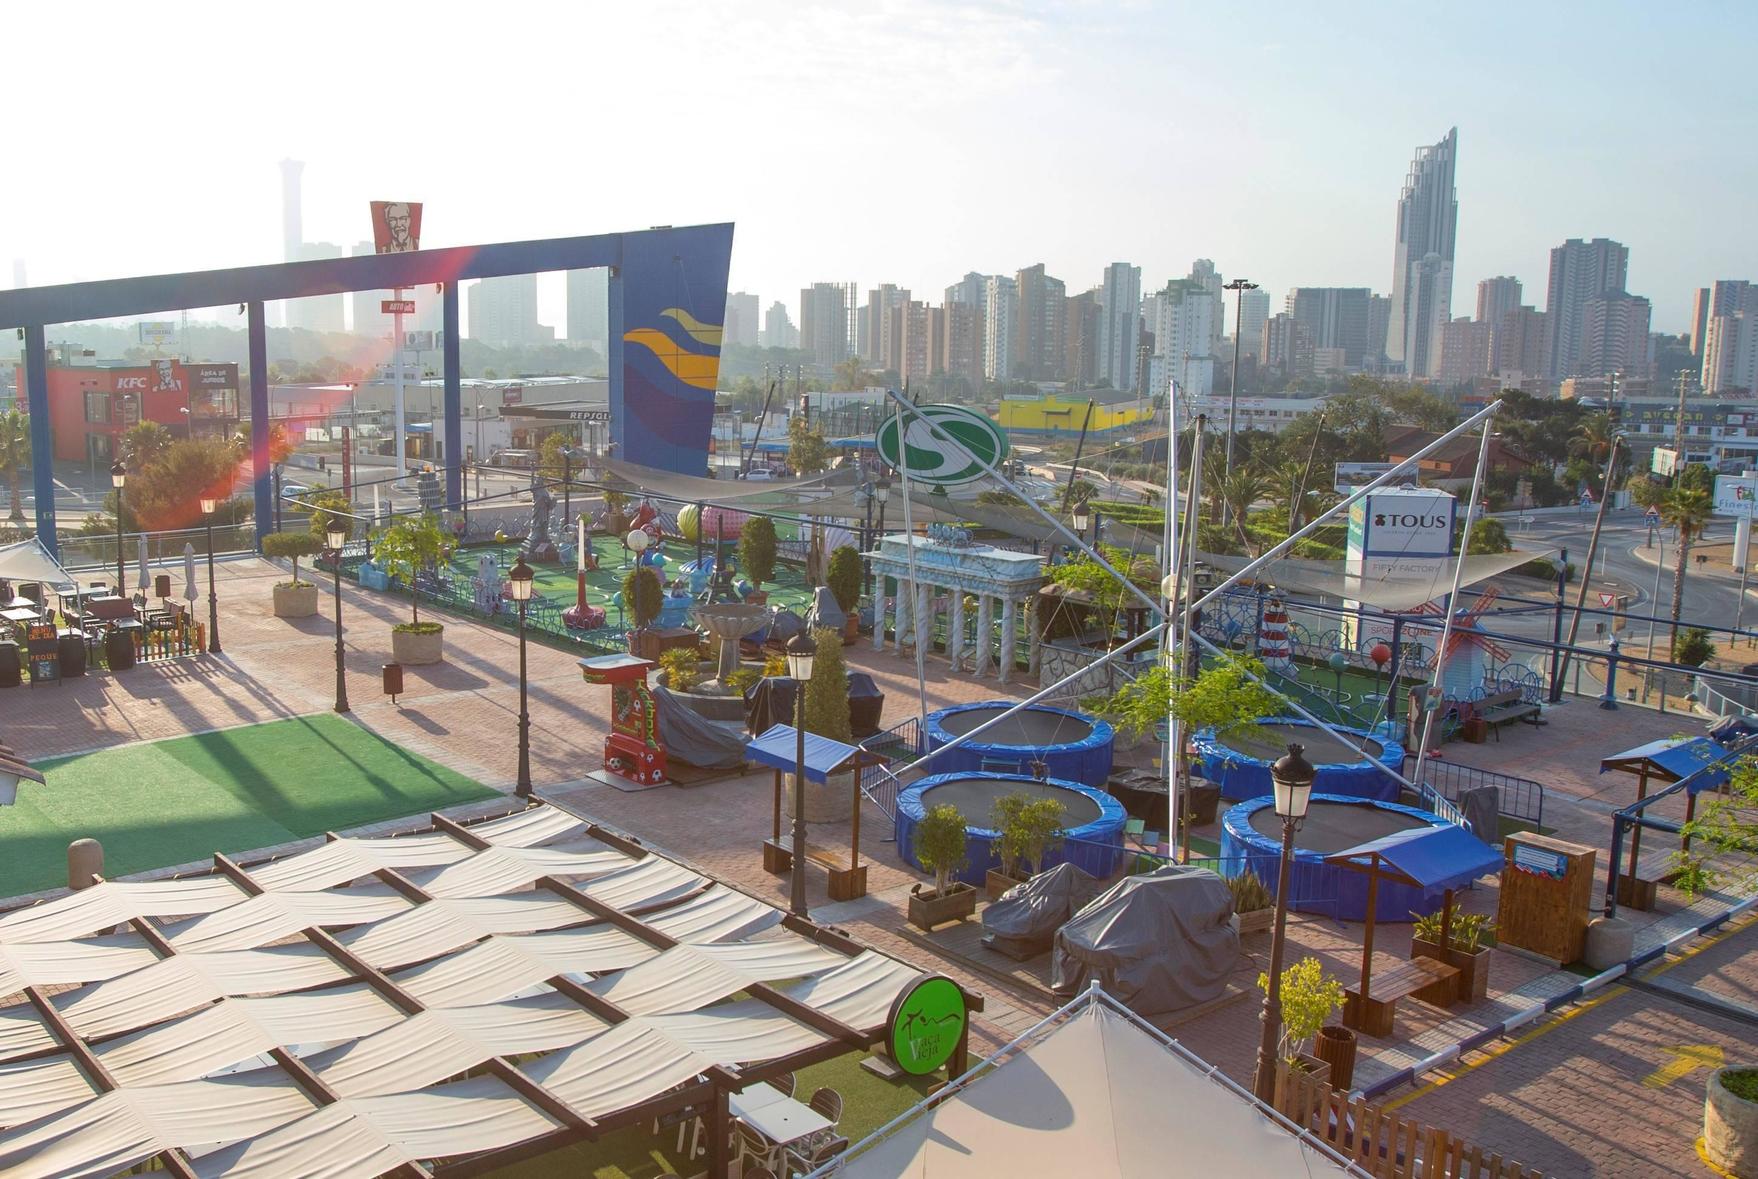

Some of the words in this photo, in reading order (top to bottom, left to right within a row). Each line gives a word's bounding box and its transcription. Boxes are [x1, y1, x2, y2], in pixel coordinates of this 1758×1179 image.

[117, 377, 147, 388] KFC
[570, 411, 608, 420] REPSOL
[1389, 514, 1446, 528] TOUS
[1400, 565, 1440, 573] FACTORY
